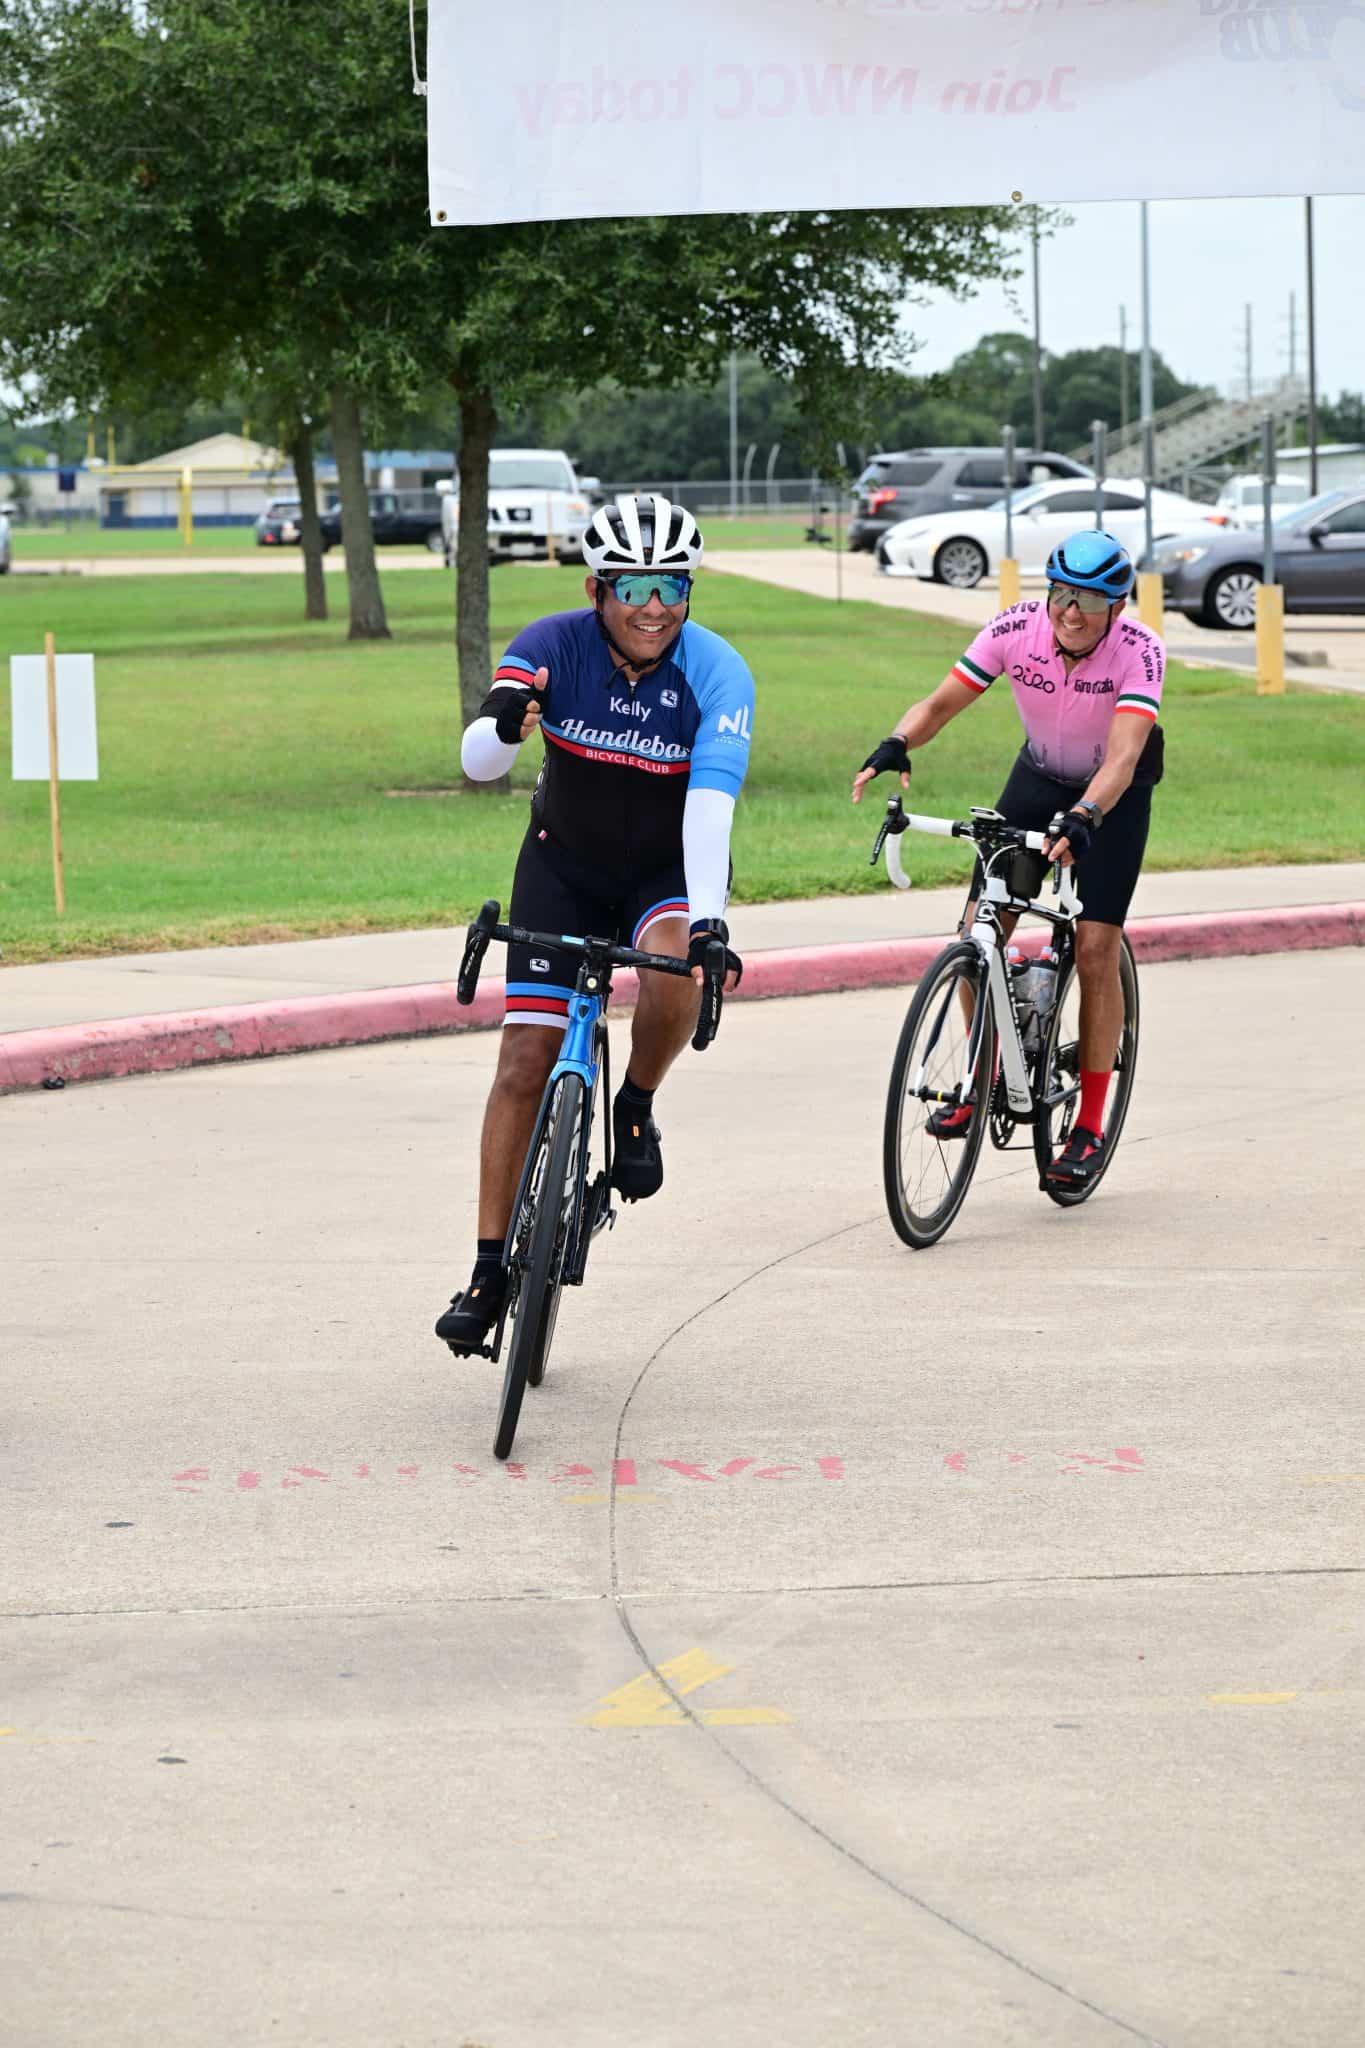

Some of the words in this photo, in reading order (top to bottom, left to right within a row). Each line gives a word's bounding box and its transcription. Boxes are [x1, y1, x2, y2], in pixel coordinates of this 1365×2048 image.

[609, 696, 652, 722] Kelly
[585, 749, 634, 766] BICYCLE
[636, 758, 670, 774] CLUB
